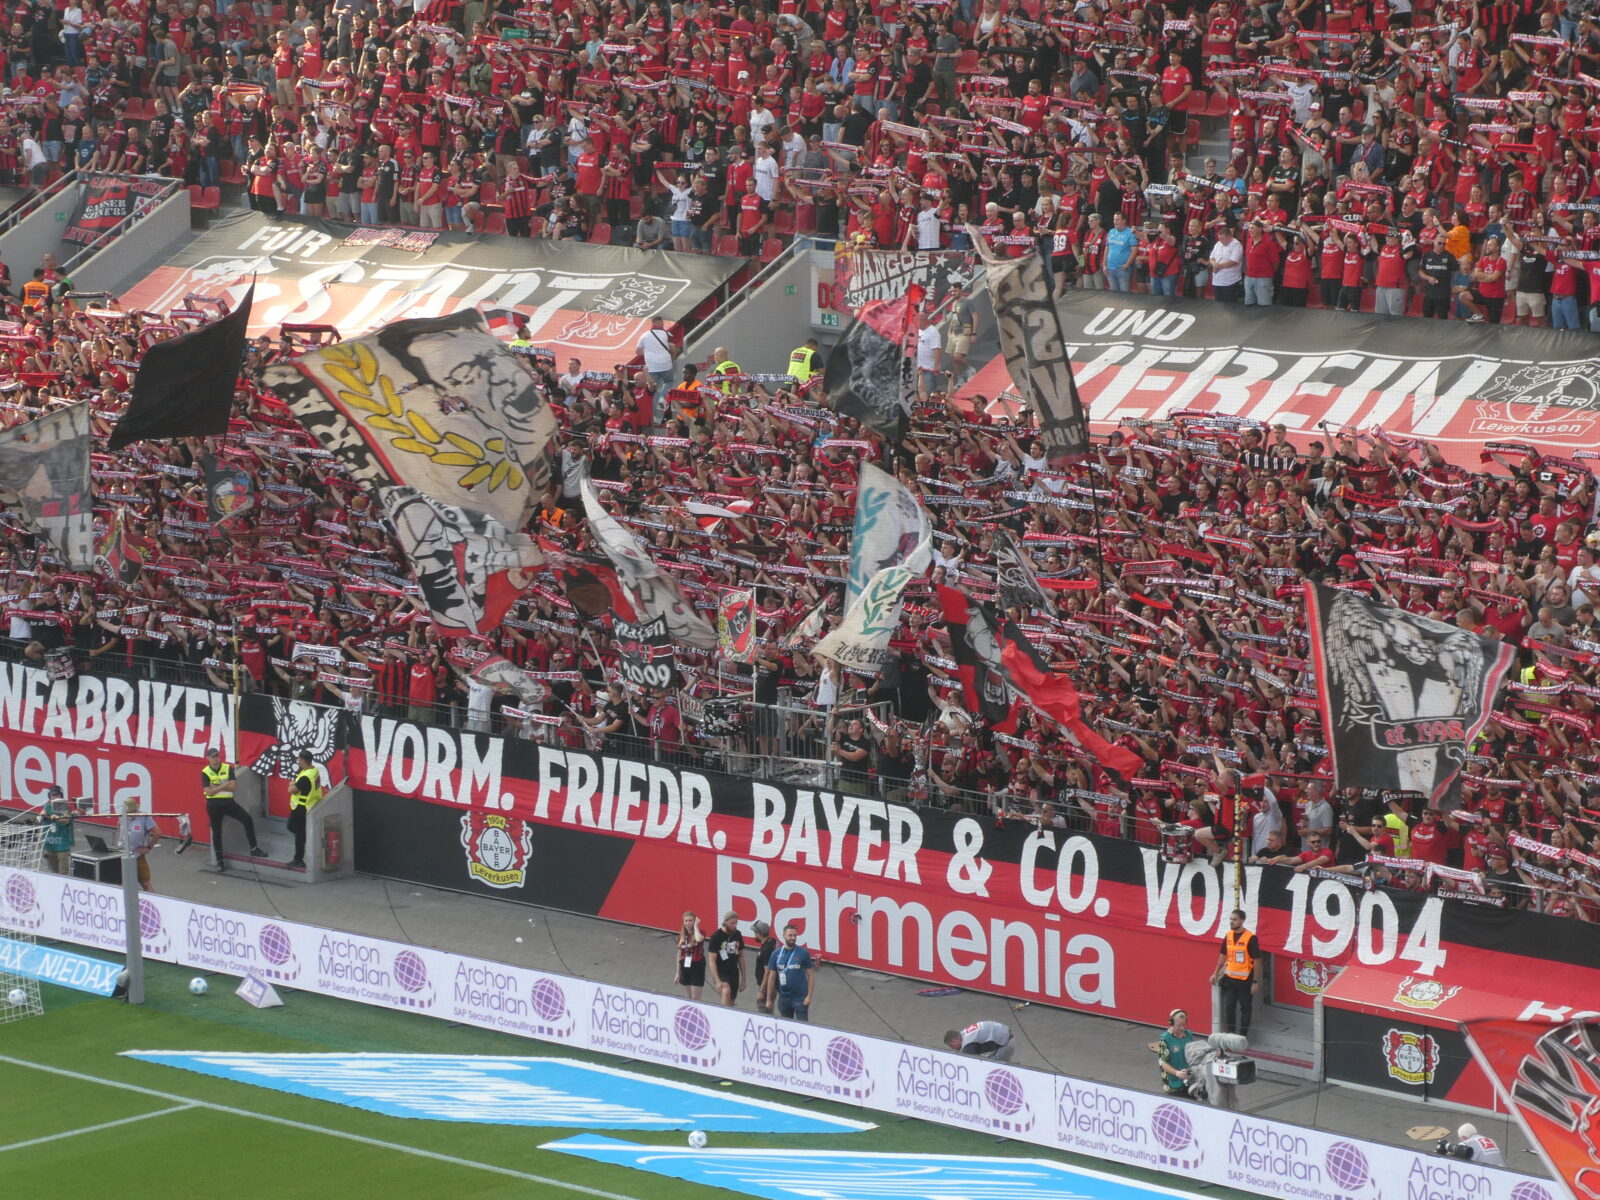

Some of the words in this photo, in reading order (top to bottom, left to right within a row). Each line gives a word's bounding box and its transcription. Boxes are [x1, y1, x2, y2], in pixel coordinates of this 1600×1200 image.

[237, 225, 332, 258] FÜR
[1083, 306, 1198, 343] UND
[1560, 364, 1596, 376] 1904
[1514, 395, 1589, 406] BAYER
[1477, 418, 1582, 434] Leverkusen
[622, 660, 671, 688] 2009
[1414, 720, 1465, 743] 1998
[488, 816, 504, 827] 1904
[361, 716, 515, 811] VORM.
[534, 745, 727, 851] FRIEDR.
[749, 782, 924, 886] BAYER
[946, 817, 993, 898] &
[1020, 829, 1111, 919] CO.
[1139, 846, 1264, 940] VON
[1283, 872, 1448, 977] 1904
[483, 843, 511, 855] BAYER
[1514, 835, 1559, 859] MEISTER
[474, 864, 520, 883] Leverkusen
[62, 882, 118, 911] Archon
[61, 902, 126, 932] Meridian
[187, 908, 246, 938] Archon
[716, 854, 1117, 1009] Barmenia
[60, 926, 73, 936] SAP
[73, 928, 100, 943] Security
[187, 928, 257, 961] Meridian
[319, 934, 380, 965] Archon
[37, 952, 121, 992] NIEDAX
[188, 953, 200, 962] SAP
[201, 954, 228, 969] Security
[318, 954, 390, 987] Meridian
[455, 960, 517, 993] Archon
[318, 979, 331, 989] SAP
[332, 980, 359, 996] Security
[360, 987, 398, 1005] Consulting
[455, 982, 528, 1017] Meridian
[593, 986, 659, 1019] Archon
[454, 1006, 467, 1017] SAP
[468, 1009, 496, 1025] Security
[497, 1016, 536, 1035] Consulting
[591, 1008, 670, 1045] Meridian
[743, 1017, 811, 1051] Archon
[591, 1034, 605, 1045] SAP
[607, 1037, 636, 1053] Security
[638, 1044, 679, 1064] Consulting
[743, 1039, 823, 1077] Meridian
[742, 1065, 756, 1076] SAP
[757, 1068, 789, 1086] Security
[790, 1076, 832, 1095] Consulting
[898, 1048, 969, 1084] Archon
[897, 1071, 981, 1109] Meridian
[1059, 1081, 1135, 1118] Archon
[896, 1097, 911, 1109] SAP
[913, 1100, 947, 1118] Security
[949, 1109, 991, 1128] Consulting
[1059, 1104, 1148, 1145] Meridian
[1057, 1131, 1074, 1144] SAP
[1075, 1135, 1109, 1154] Security
[1111, 1144, 1157, 1165] Consulting
[1229, 1118, 1308, 1157] Archon
[1228, 1141, 1321, 1184] Meridian
[1408, 1157, 1492, 1196] Archon
[1227, 1169, 1244, 1183] SAP
[1246, 1173, 1281, 1193] Security
[1282, 1180, 1332, 1200] Consulting
